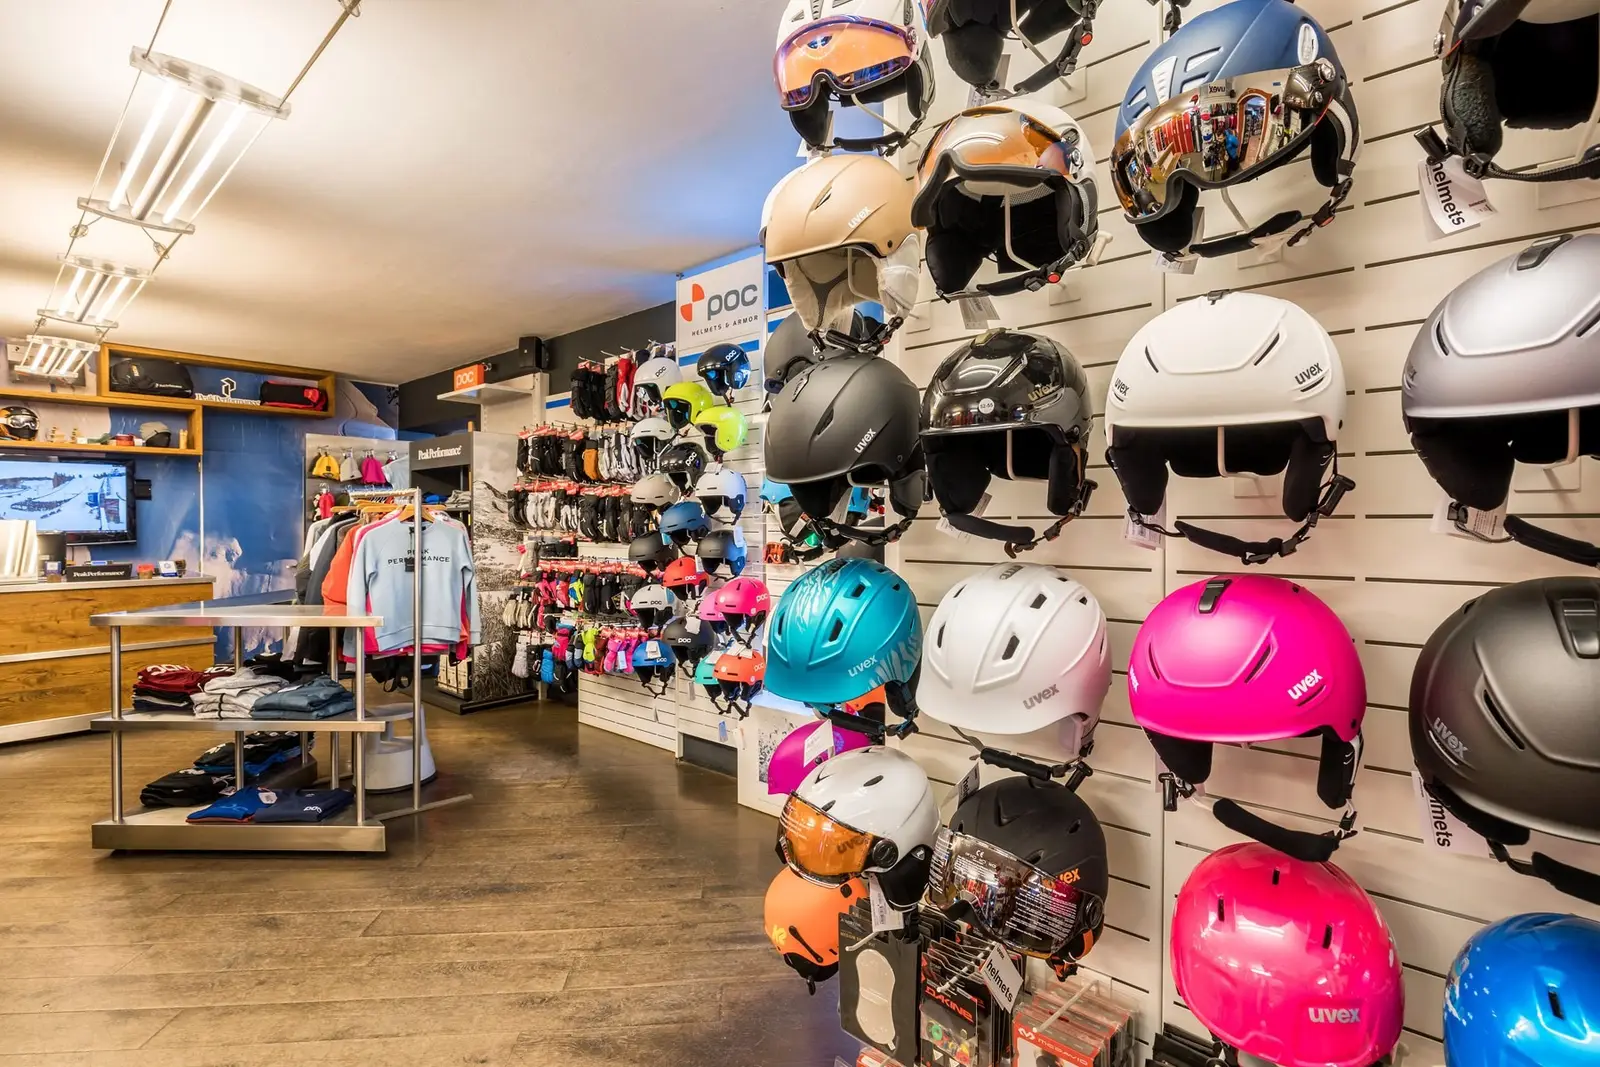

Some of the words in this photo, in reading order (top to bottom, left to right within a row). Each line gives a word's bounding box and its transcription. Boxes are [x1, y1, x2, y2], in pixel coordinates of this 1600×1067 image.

[847, 206, 872, 229] uvex
[692, 324, 722, 337] HELMETS
[733, 315, 759, 327] ARMOR
[1295, 362, 1324, 385] uvex
[1114, 376, 1130, 397] uvex
[854, 428, 877, 454] uvex
[848, 654, 879, 678] uvex
[1022, 683, 1060, 711] uvex
[1287, 668, 1323, 701] uvex
[1433, 717, 1468, 759] uvex
[986, 959, 1014, 1003] helmets
[925, 985, 975, 1023] DAKINE
[1308, 1006, 1361, 1025] uvex
